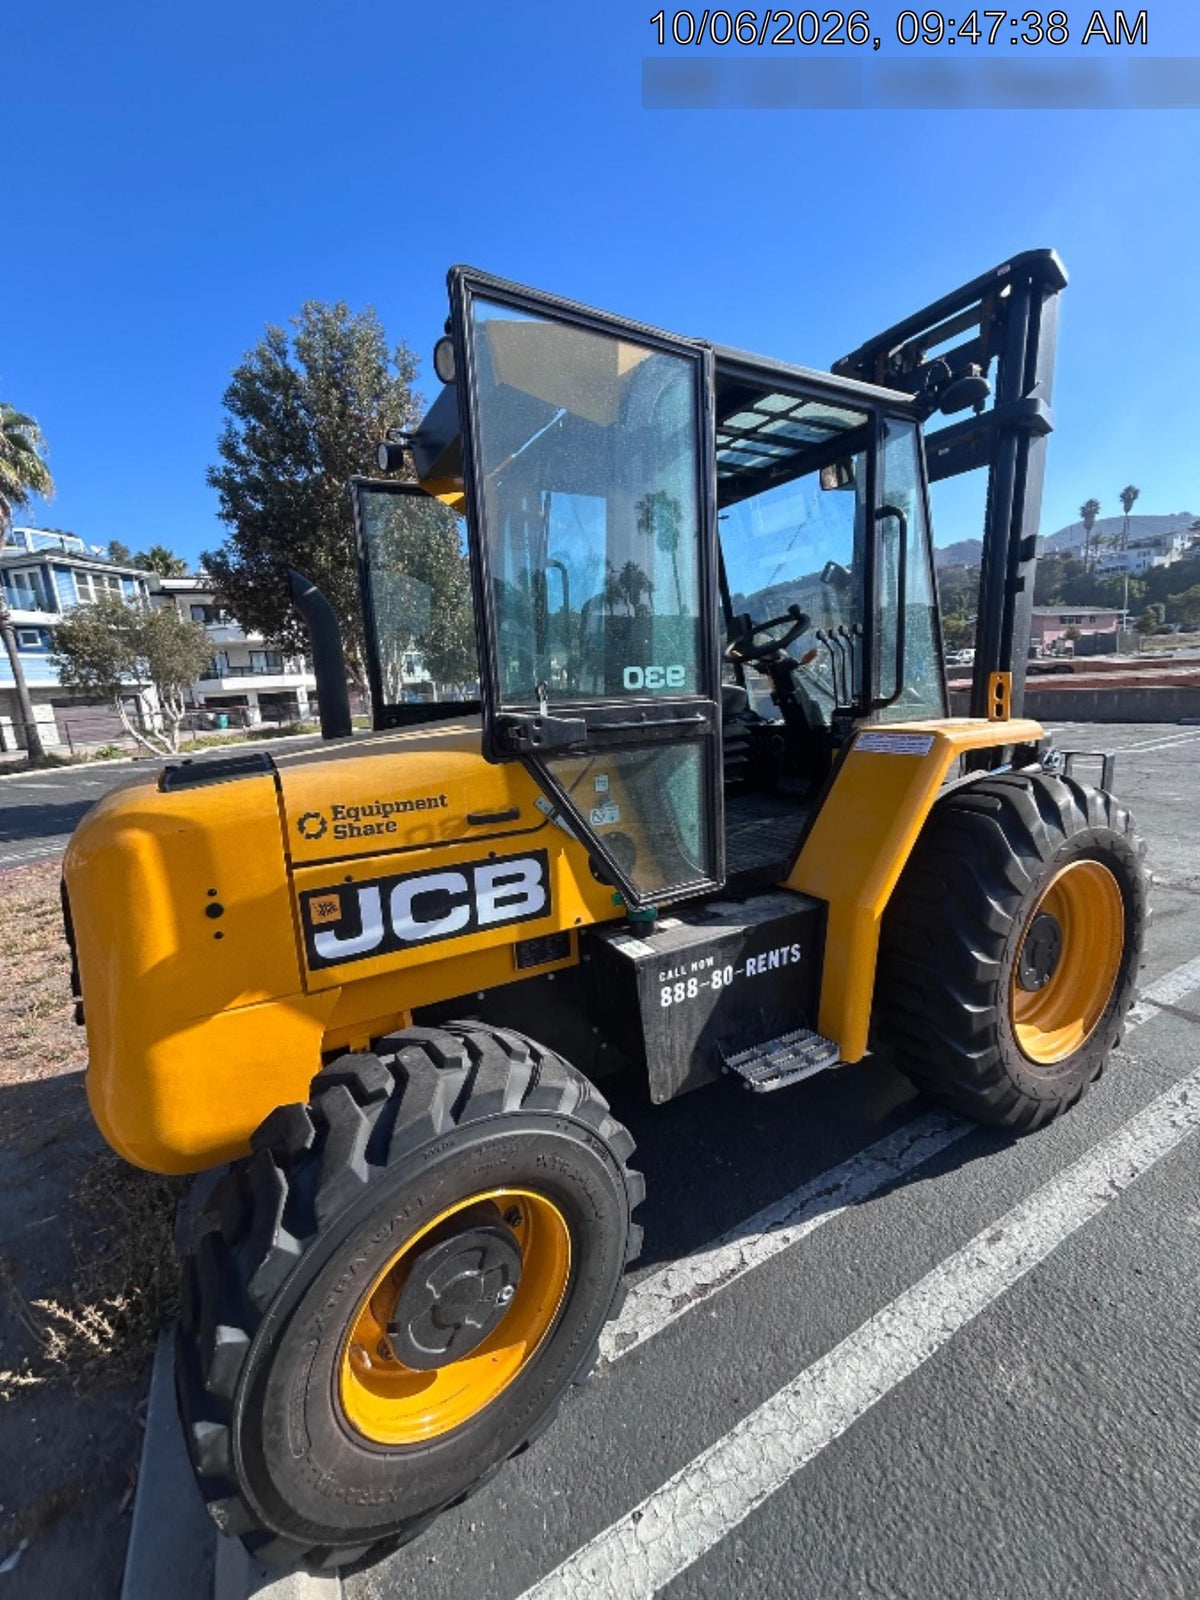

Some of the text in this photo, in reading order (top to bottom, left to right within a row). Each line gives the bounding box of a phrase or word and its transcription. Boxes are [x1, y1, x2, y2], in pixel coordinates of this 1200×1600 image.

[331, 793, 448, 822] Equipment
[333, 820, 397, 840] Share
[313, 857, 547, 960] JCB
[659, 956, 714, 982] CALL NOW
[660, 943, 801, 1007] 888-80-RENTS
